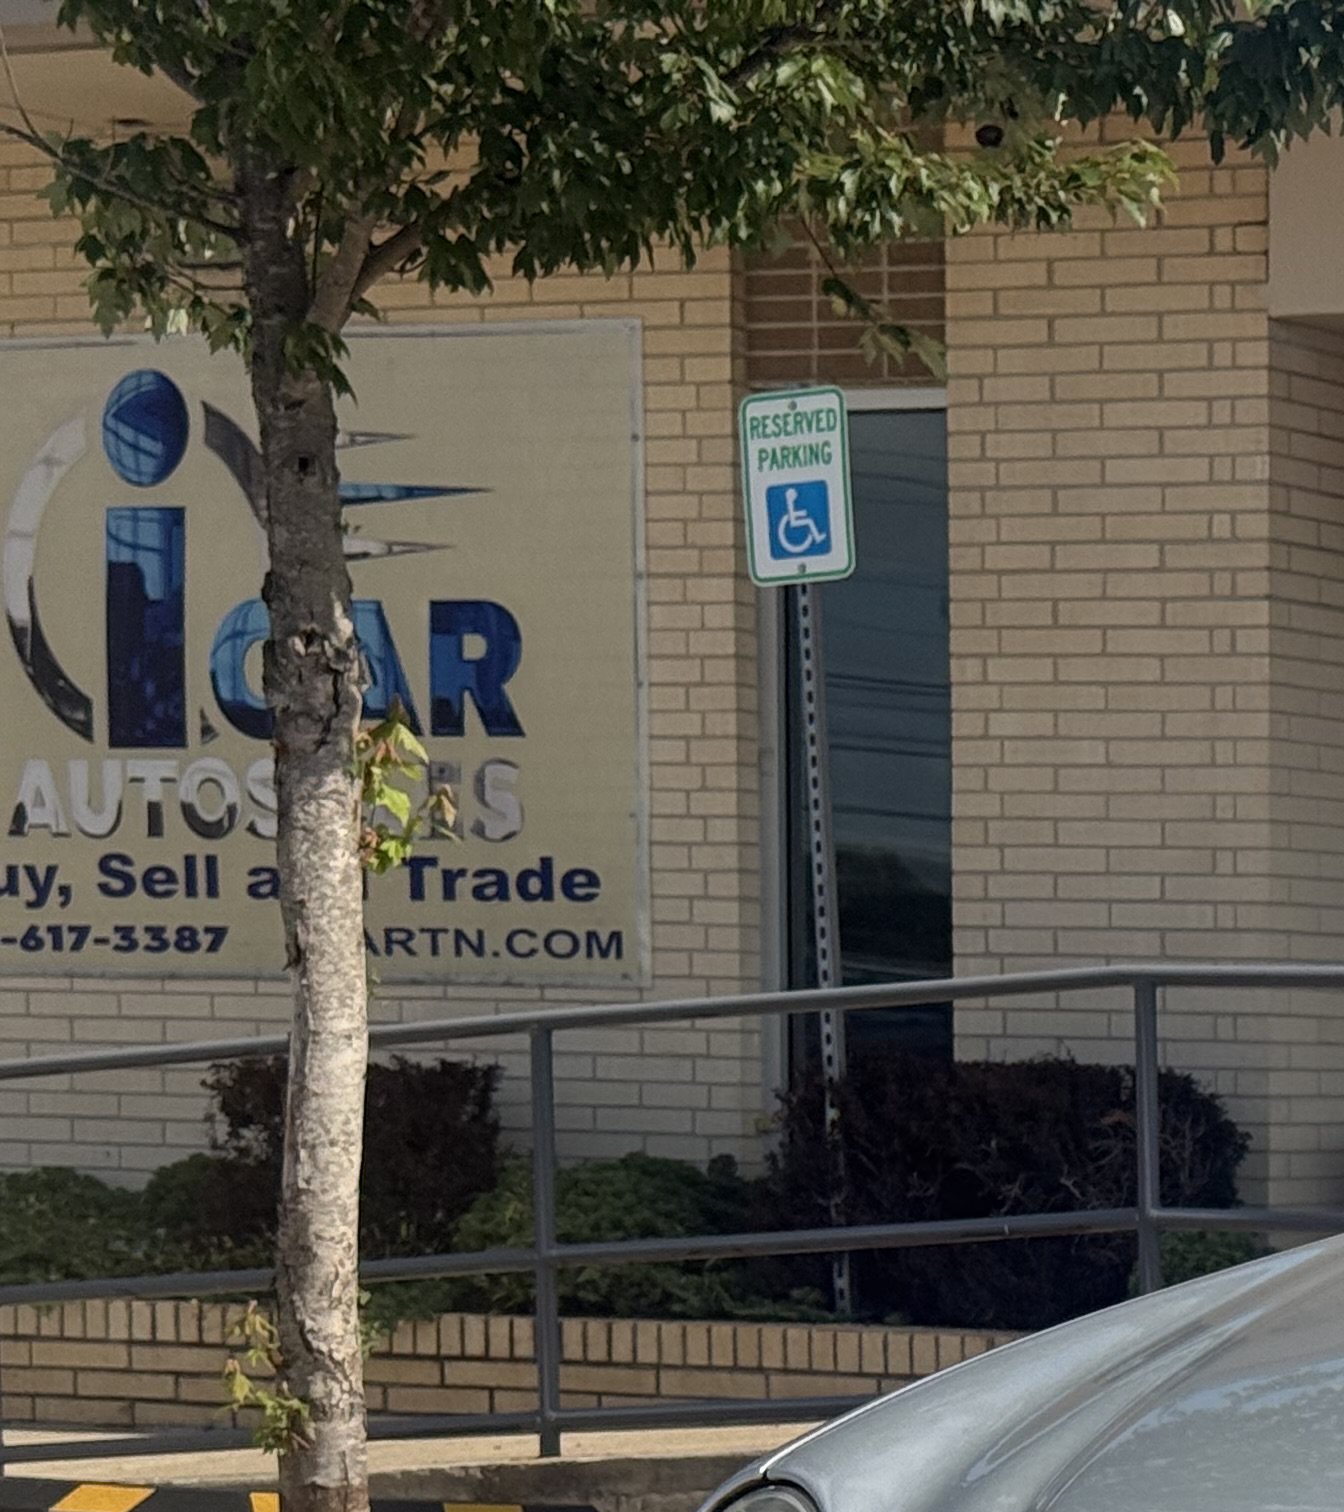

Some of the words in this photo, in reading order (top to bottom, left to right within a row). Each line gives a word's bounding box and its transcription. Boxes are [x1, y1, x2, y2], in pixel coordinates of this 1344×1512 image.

[749, 408, 838, 440] RESERVED
[757, 440, 832, 472] PARKING
[97, 853, 219, 899] Sell
[401, 855, 602, 903] Trade
